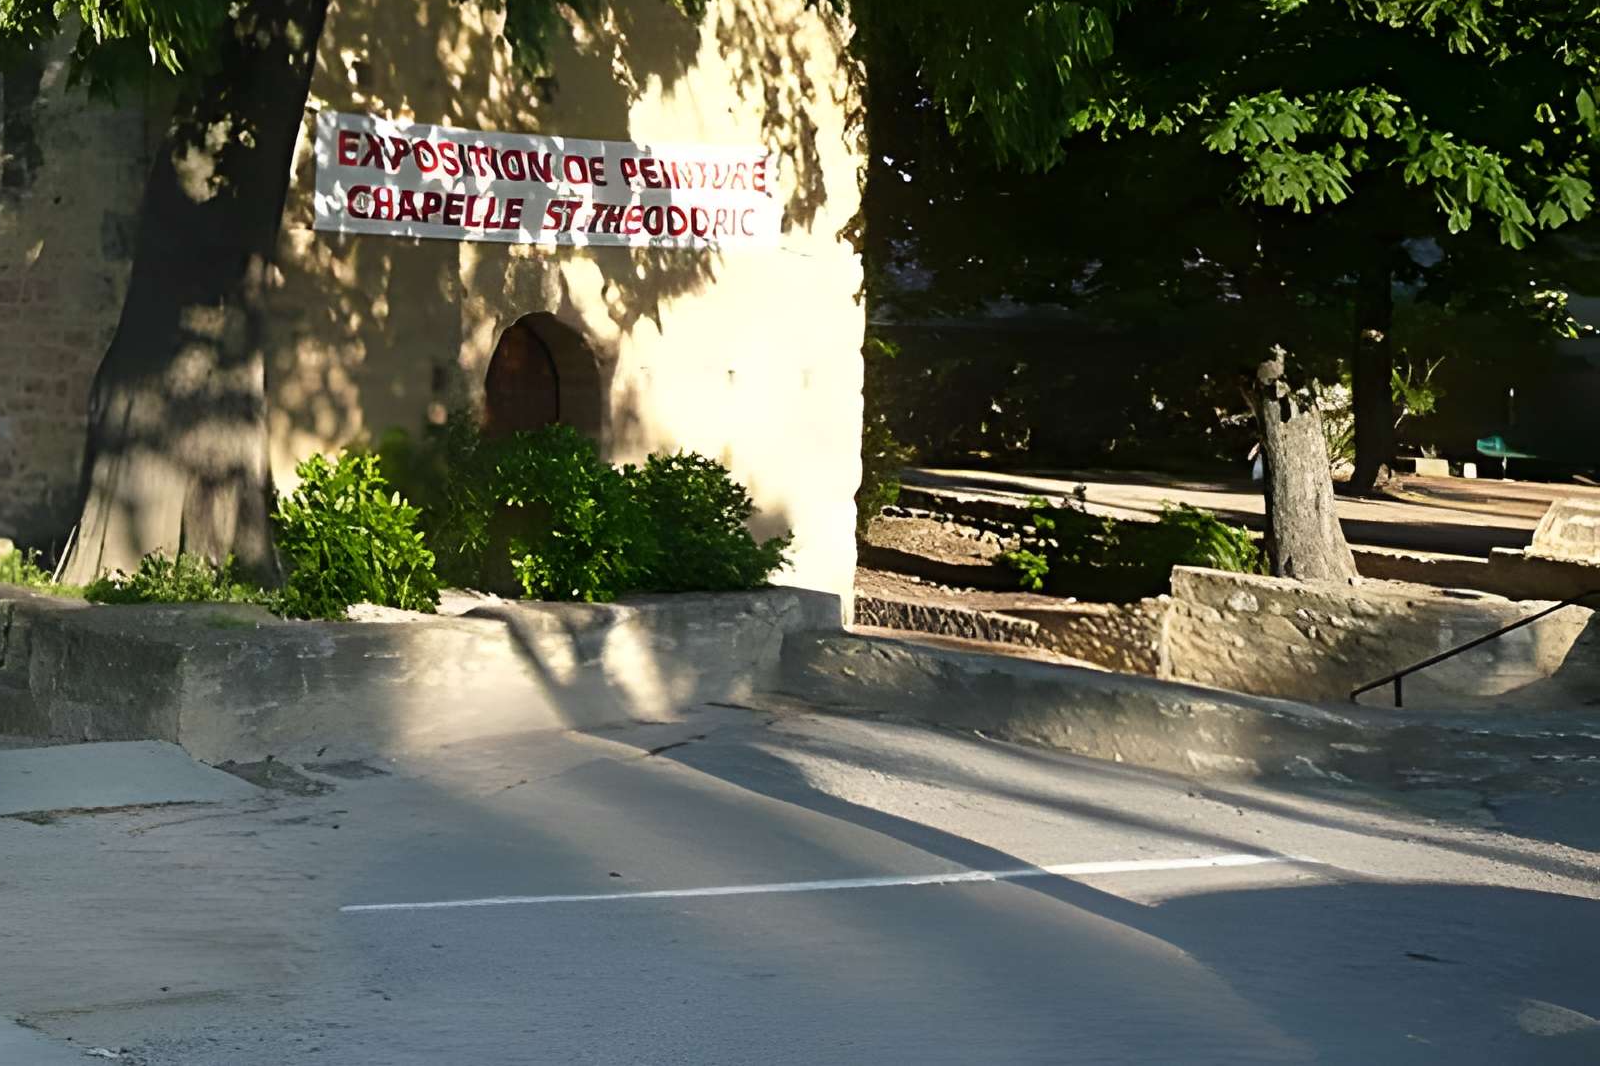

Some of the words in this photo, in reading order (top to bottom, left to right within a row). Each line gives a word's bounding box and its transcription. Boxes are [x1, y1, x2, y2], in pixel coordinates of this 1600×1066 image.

[338, 129, 553, 183] EXPOSITION
[563, 155, 608, 186] DE
[619, 156, 766, 193] PEINTURE
[347, 185, 525, 230] CHAPELLE
